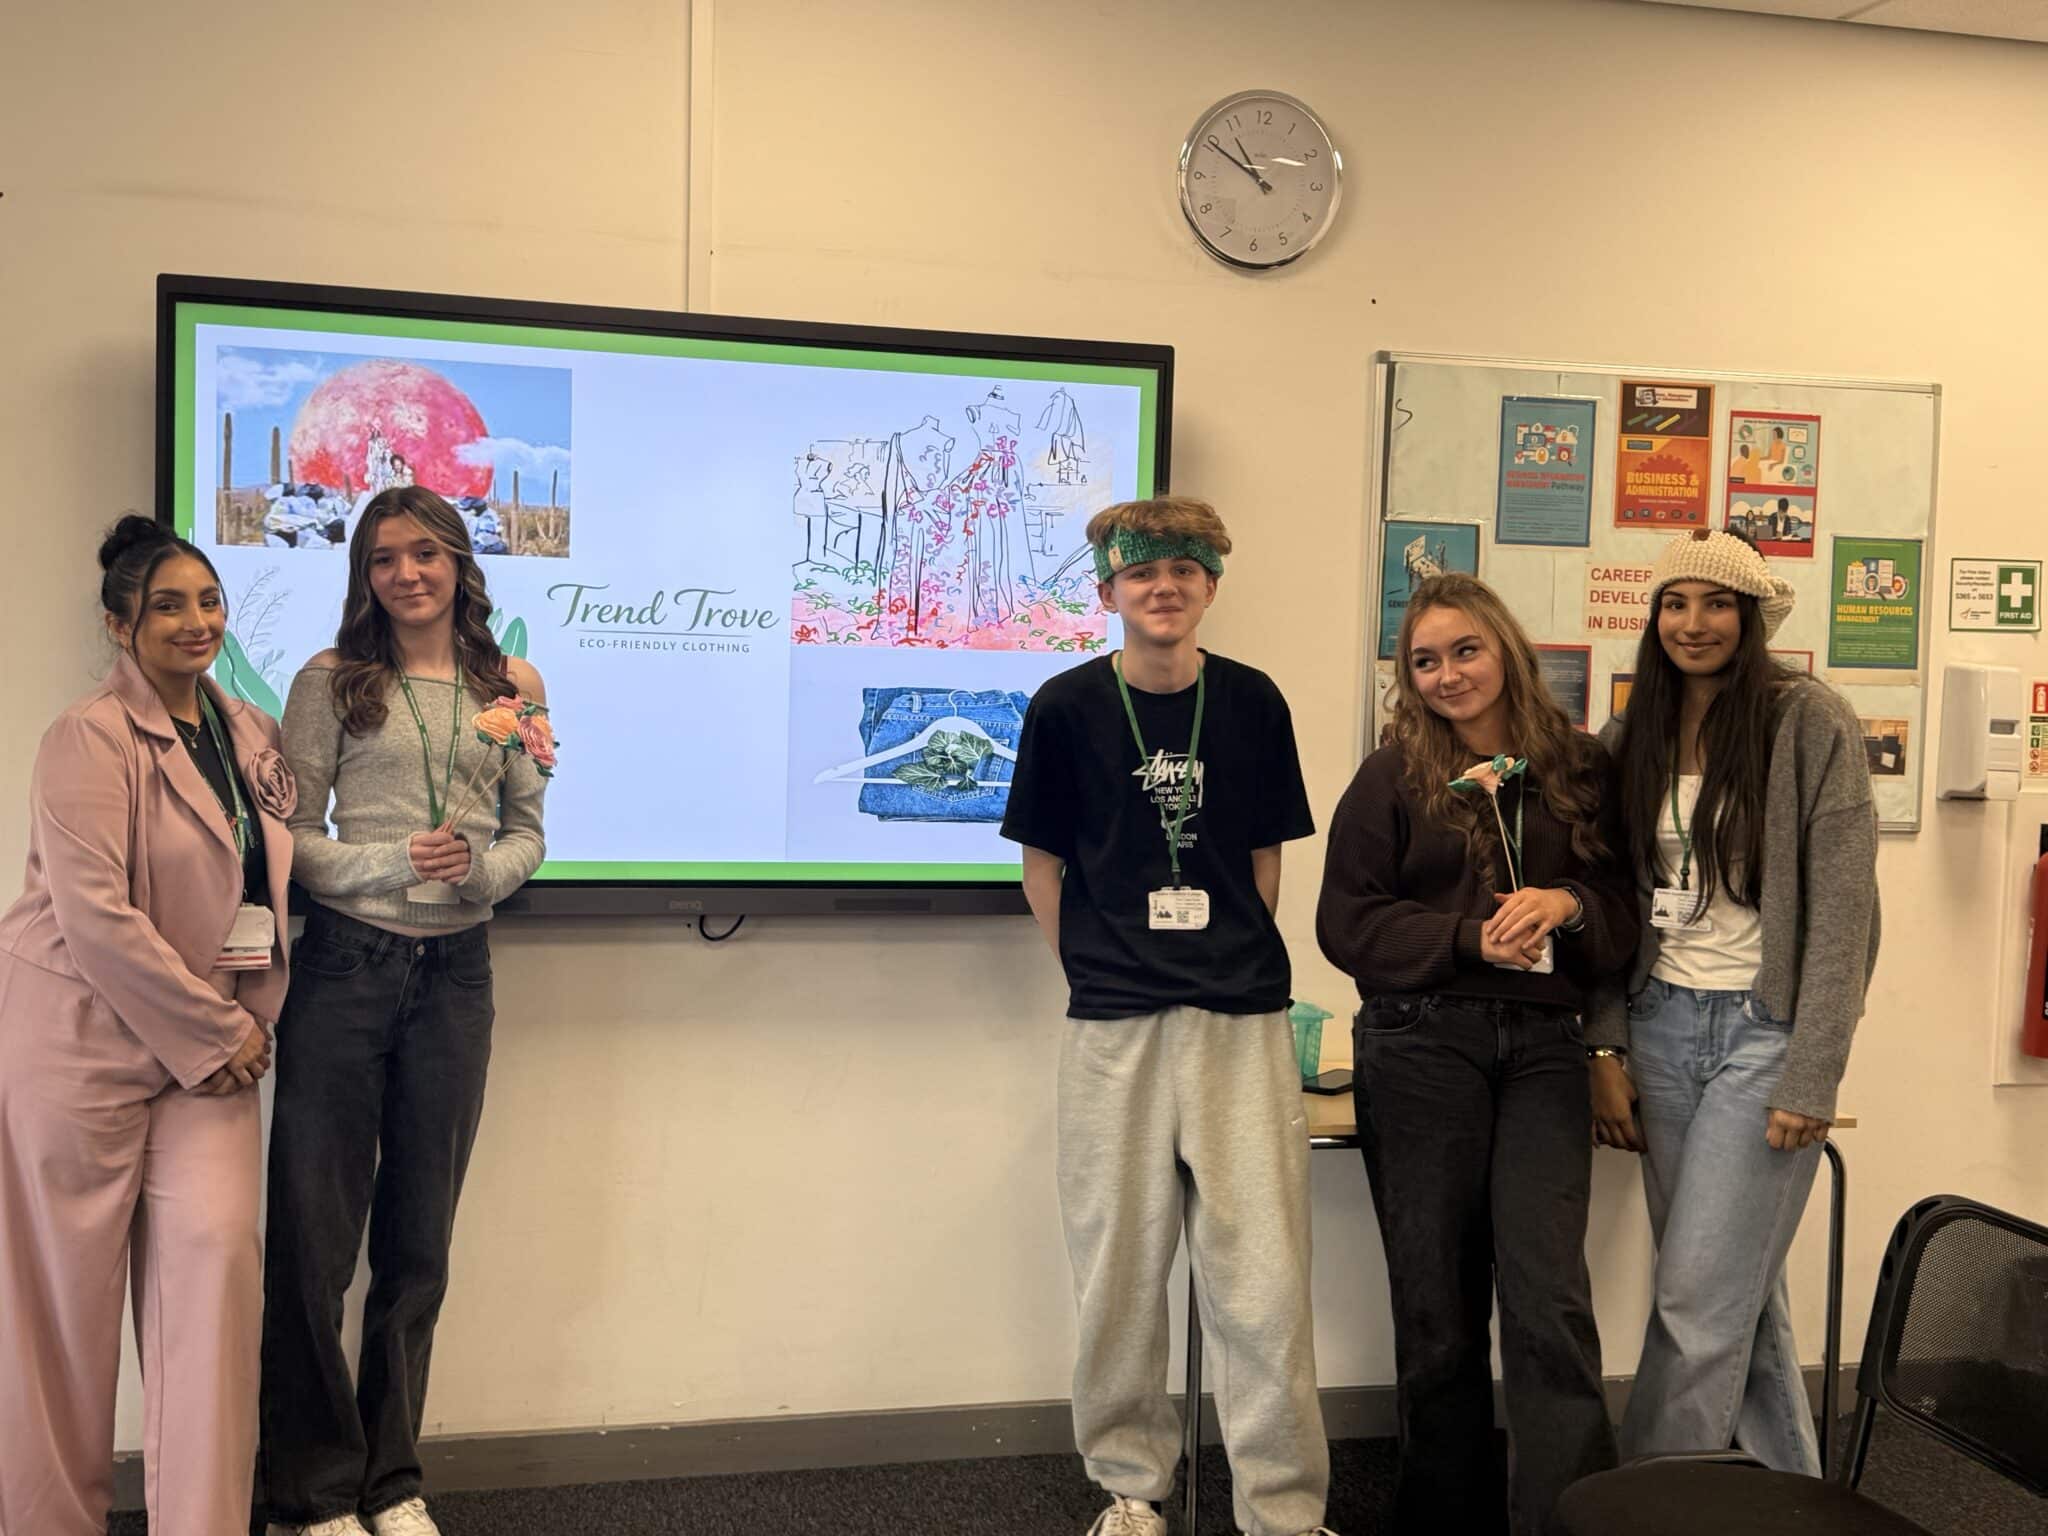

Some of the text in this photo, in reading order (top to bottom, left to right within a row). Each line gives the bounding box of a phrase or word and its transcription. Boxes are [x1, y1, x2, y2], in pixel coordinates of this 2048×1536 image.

[1226, 115, 1241, 132] 11
[1256, 110, 1273, 126] 12
[1288, 122, 1296, 135] 1
[1202, 134, 1220, 153] 10
[1303, 149, 1318, 161] 2
[1193, 170, 1207, 181] 9
[1309, 181, 1323, 192] 3
[1199, 202, 1213, 214] 8
[1302, 212, 1312, 223] 4
[1219, 226, 1232, 239] 7
[1278, 232, 1288, 246] 5
[1249, 238, 1258, 252] 6
[1626, 471, 1700, 487] BUSINESS &
[1625, 484, 1699, 498] ADMINISTRATION
[1590, 590, 1649, 605] DEVELO
[546, 583, 781, 632] Trend Trove
[1836, 604, 1913, 616] HUMAN RESOURCES
[1588, 615, 1603, 629] IN
[2020, 612, 2032, 620] AID
[579, 638, 750, 653] ECO-FRIENDLY CLOTHING
[1154, 786, 1173, 794] NEW
[1150, 795, 1166, 803] LOS
